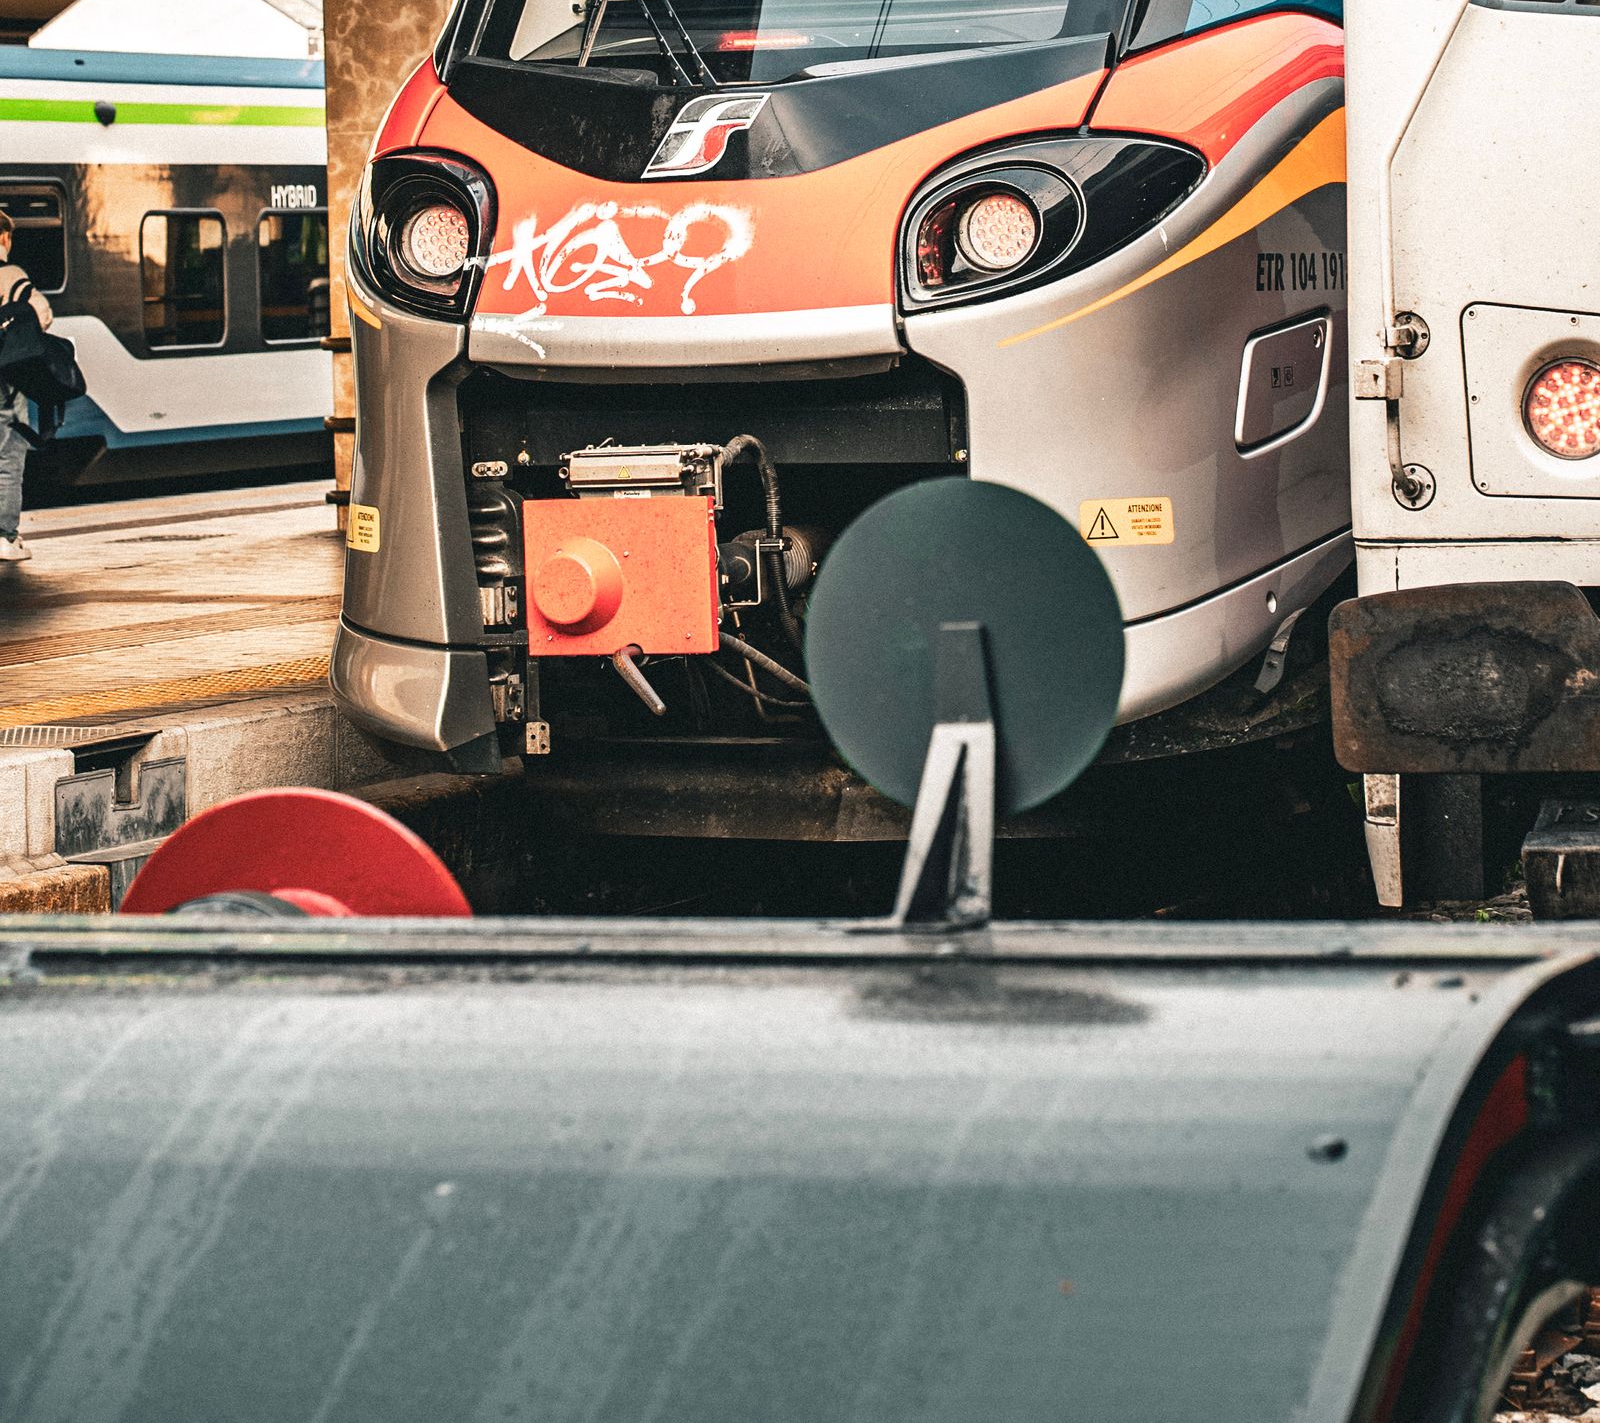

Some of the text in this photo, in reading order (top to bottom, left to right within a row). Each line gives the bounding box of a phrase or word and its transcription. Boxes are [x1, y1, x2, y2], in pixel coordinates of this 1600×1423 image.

[271, 184, 317, 209] HYBRID
[1256, 252, 1285, 292] ETR
[1290, 252, 1317, 291] 104
[1127, 503, 1162, 513] ATTENZIONE
